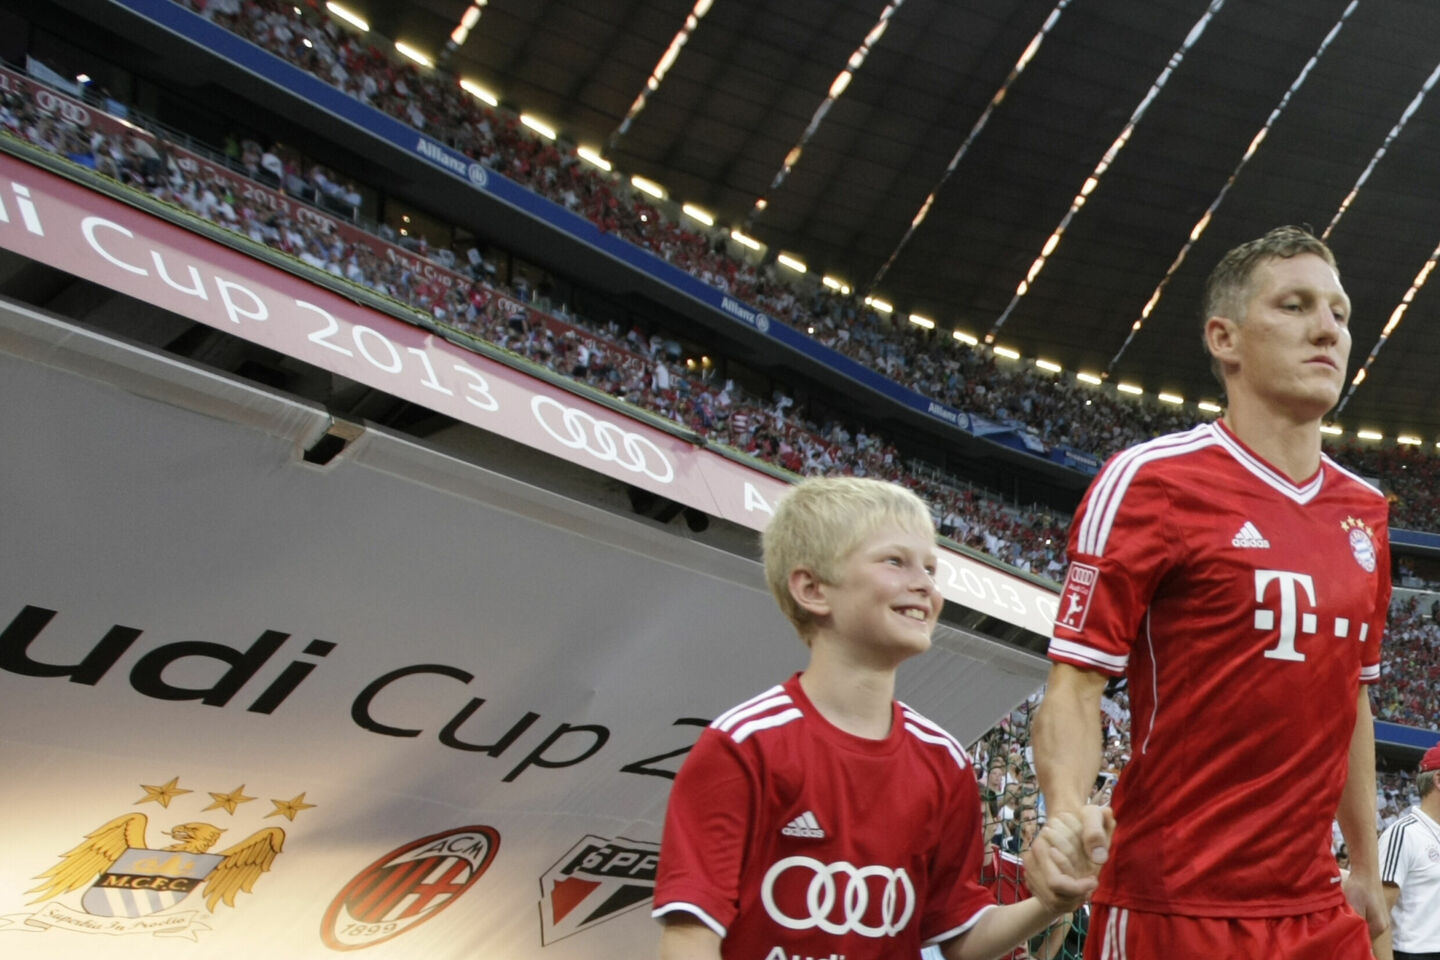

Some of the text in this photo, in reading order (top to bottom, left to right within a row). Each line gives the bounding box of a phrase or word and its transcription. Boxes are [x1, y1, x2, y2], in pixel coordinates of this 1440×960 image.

[416, 137, 467, 176] Allianz
[81, 216, 269, 324] Cup
[295, 300, 500, 413] 2013
[720, 296, 756, 325] Allianz
[927, 400, 958, 425] Allianz
[0, 604, 338, 716] udi
[350, 663, 611, 784] Cup
[414, 835, 483, 859] ACM
[103, 874, 188, 892] M.C.F.C.
[339, 922, 399, 938] 1899
